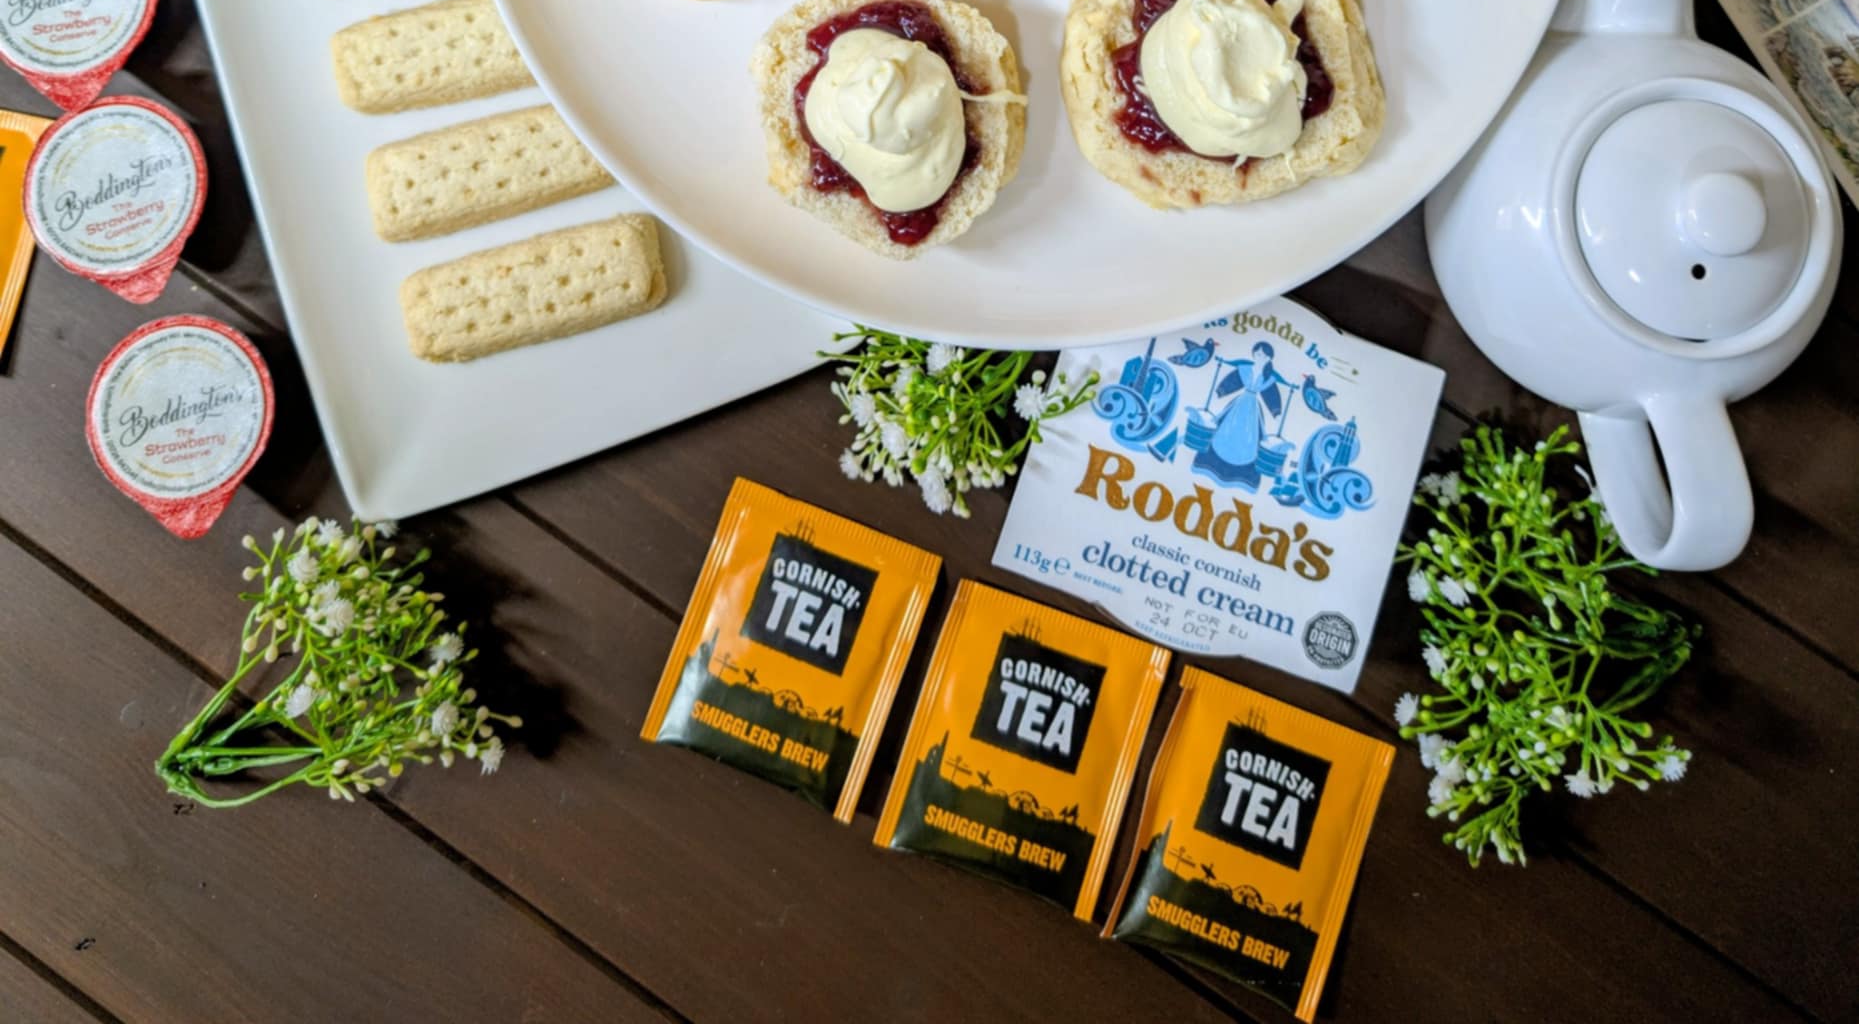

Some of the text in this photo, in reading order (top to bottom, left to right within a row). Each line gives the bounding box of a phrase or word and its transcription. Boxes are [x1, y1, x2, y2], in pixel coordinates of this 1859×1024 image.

[32, 15, 112, 36] Strawberry
[85, 199, 165, 236] Strawberry
[1232, 311, 1328, 369] godda be
[144, 434, 226, 456] Strawberry
[162, 449, 211, 465] Conserve
[1074, 443, 1334, 582] Rodda's
[1082, 540, 1295, 636] clotted cream
[1131, 534, 1262, 592] classic cornish
[765, 580, 845, 657] TEA
[1150, 612, 1220, 642] 24 OCT
[1184, 609, 1220, 627] FOR
[1228, 624, 1249, 640] EU
[1309, 628, 1351, 656] ORIGIN
[691, 699, 829, 773] SMUGGLERS BREW
[997, 680, 1075, 755] TEA
[924, 804, 1067, 872] SMUGGLERS BREW
[1221, 771, 1299, 850] TEA
[1147, 895, 1290, 970] SMUGGLERS BREW
